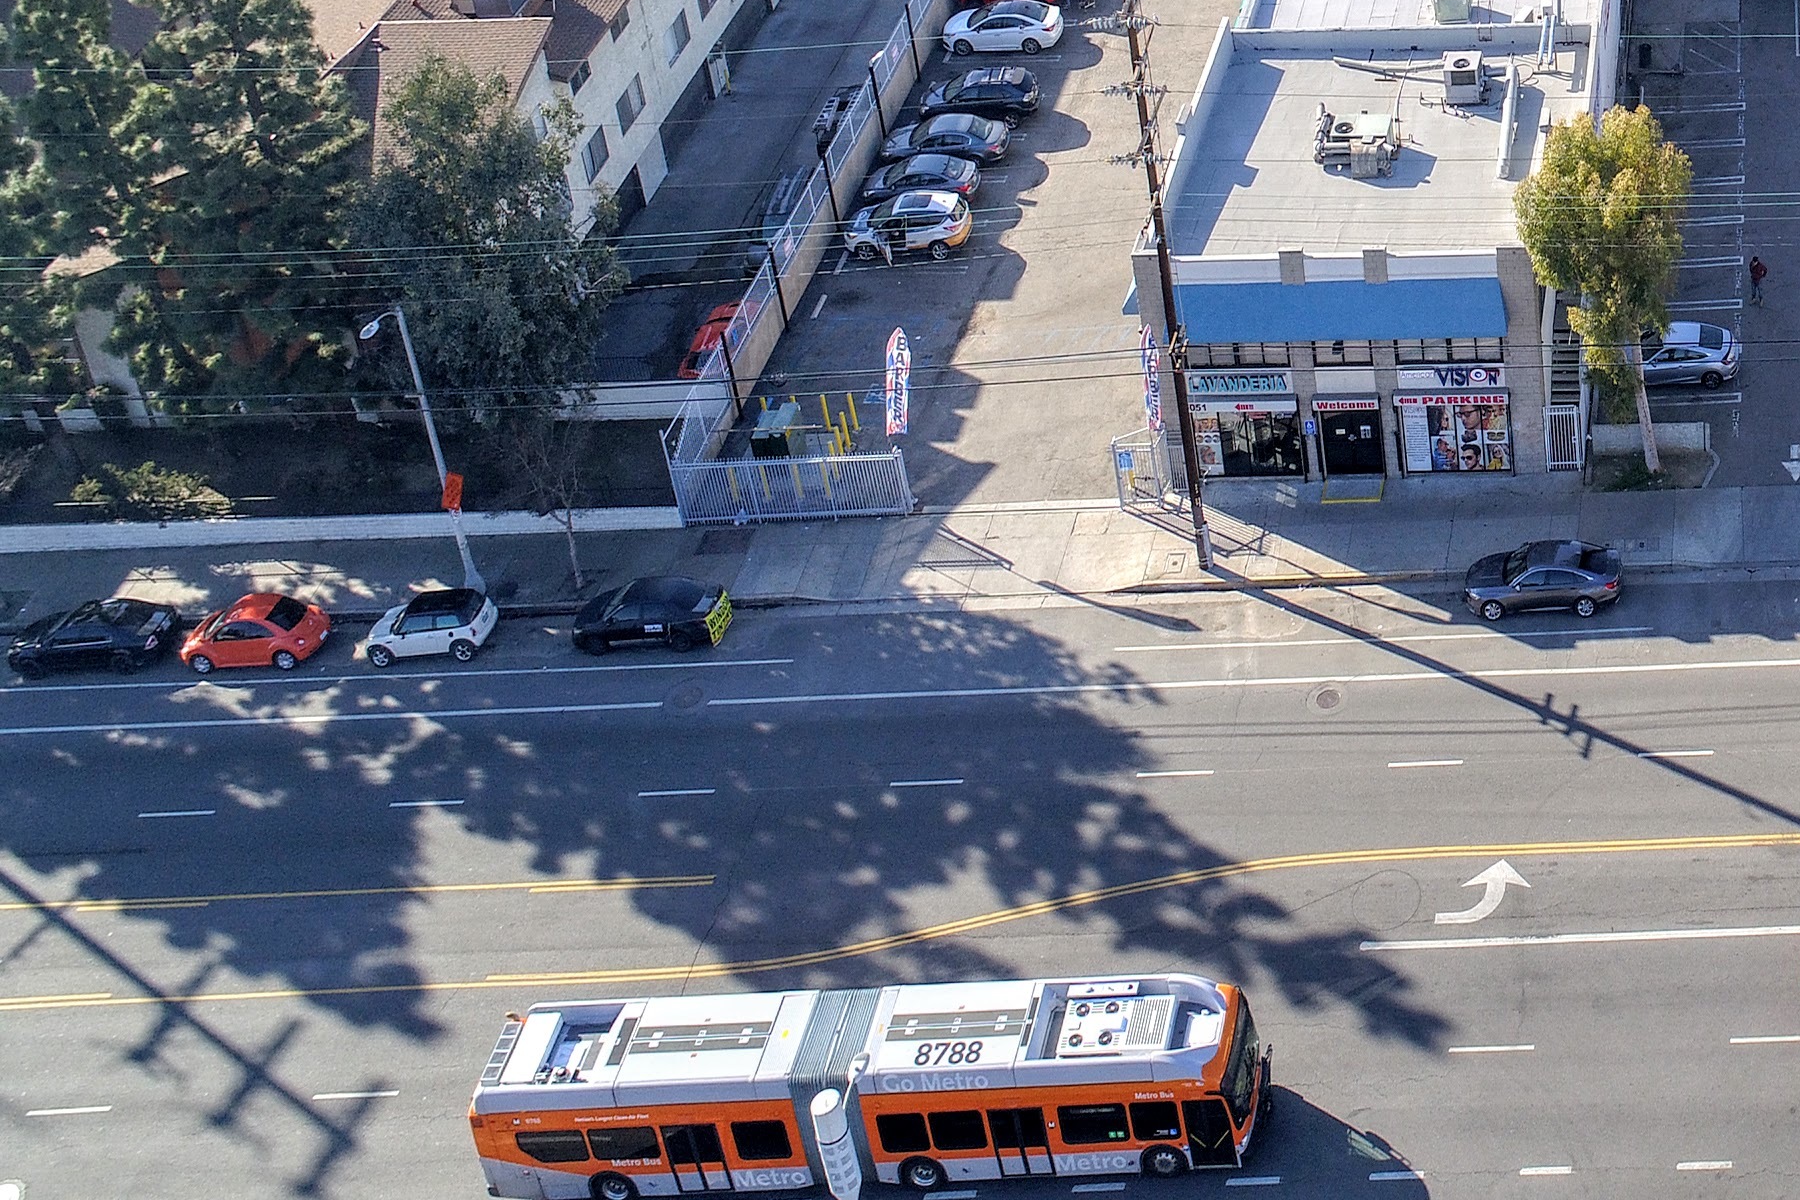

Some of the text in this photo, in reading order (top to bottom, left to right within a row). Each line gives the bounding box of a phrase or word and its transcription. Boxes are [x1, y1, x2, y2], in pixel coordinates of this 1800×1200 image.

[1188, 373, 1288, 393] LAVANDERIA
[1434, 368, 1500, 386] VISION
[1316, 402, 1376, 410] Welcome
[1422, 396, 1505, 404] PARKING
[913, 1041, 983, 1066] 8788
[882, 1071, 990, 1093] Go Metro
[1134, 1091, 1174, 1100] Metro Bus
[612, 1158, 662, 1167] Metro Bus
[1055, 1154, 1128, 1173] Metro
[734, 1168, 807, 1189] Metro
